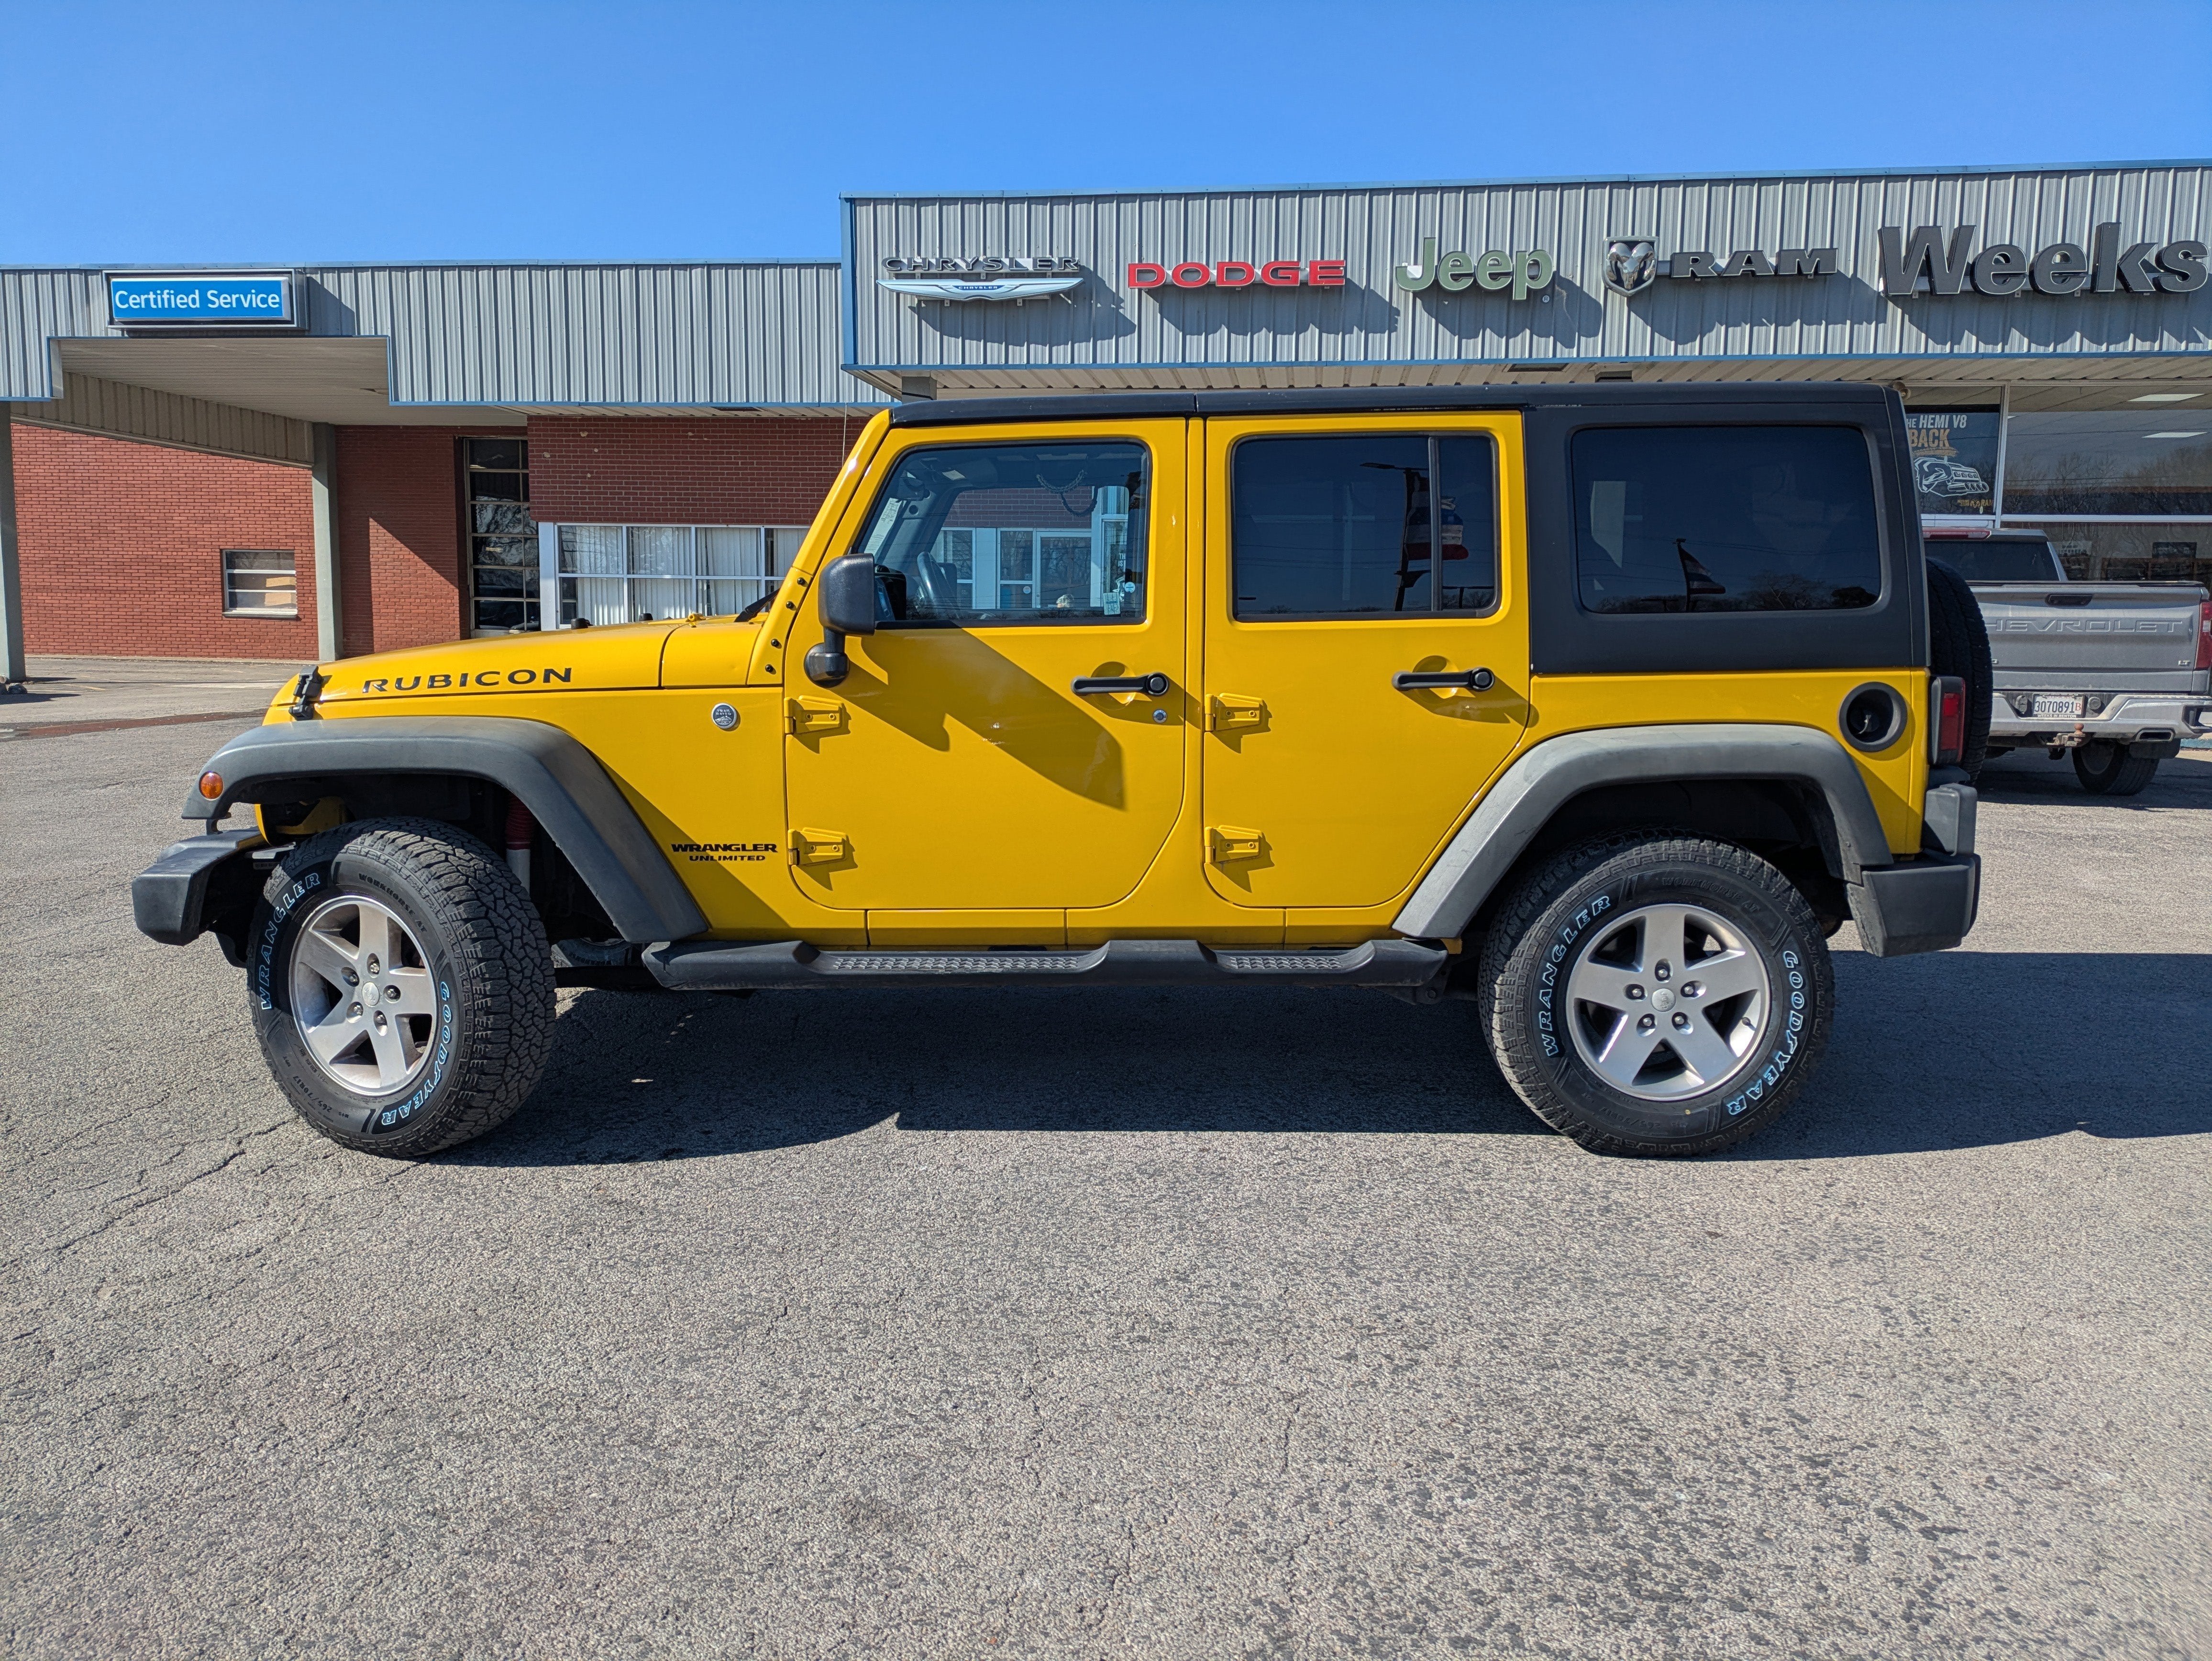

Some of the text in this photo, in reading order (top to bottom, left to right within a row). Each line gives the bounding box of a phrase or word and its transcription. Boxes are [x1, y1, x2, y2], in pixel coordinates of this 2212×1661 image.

[882, 256, 1080, 271] CHRYSLER
[1395, 237, 1553, 301] Jeep
[1670, 248, 1838, 277] RAM
[1878, 221, 2210, 296] Weeks
[1128, 260, 1346, 289] DODGE
[115, 289, 280, 309] Certified Service
[1906, 415, 1967, 428] HE HEMI V8
[1908, 429, 1950, 447] BACK
[1985, 620, 2183, 633] HEVROLET
[362, 667, 572, 694] RUBICON
[2035, 701, 2075, 713] 3070891
[671, 843, 778, 853] WRANGLER
[359, 873, 427, 932] WORKHORSE AT
[259, 872, 321, 1010] WRANGLER
[1538, 895, 1611, 1057] WRANGLER
[1726, 950, 1805, 1116] GOODYEAR
[381, 981, 452, 1125] GOODYEAR
[293, 1075, 333, 1113] 265/70R17
